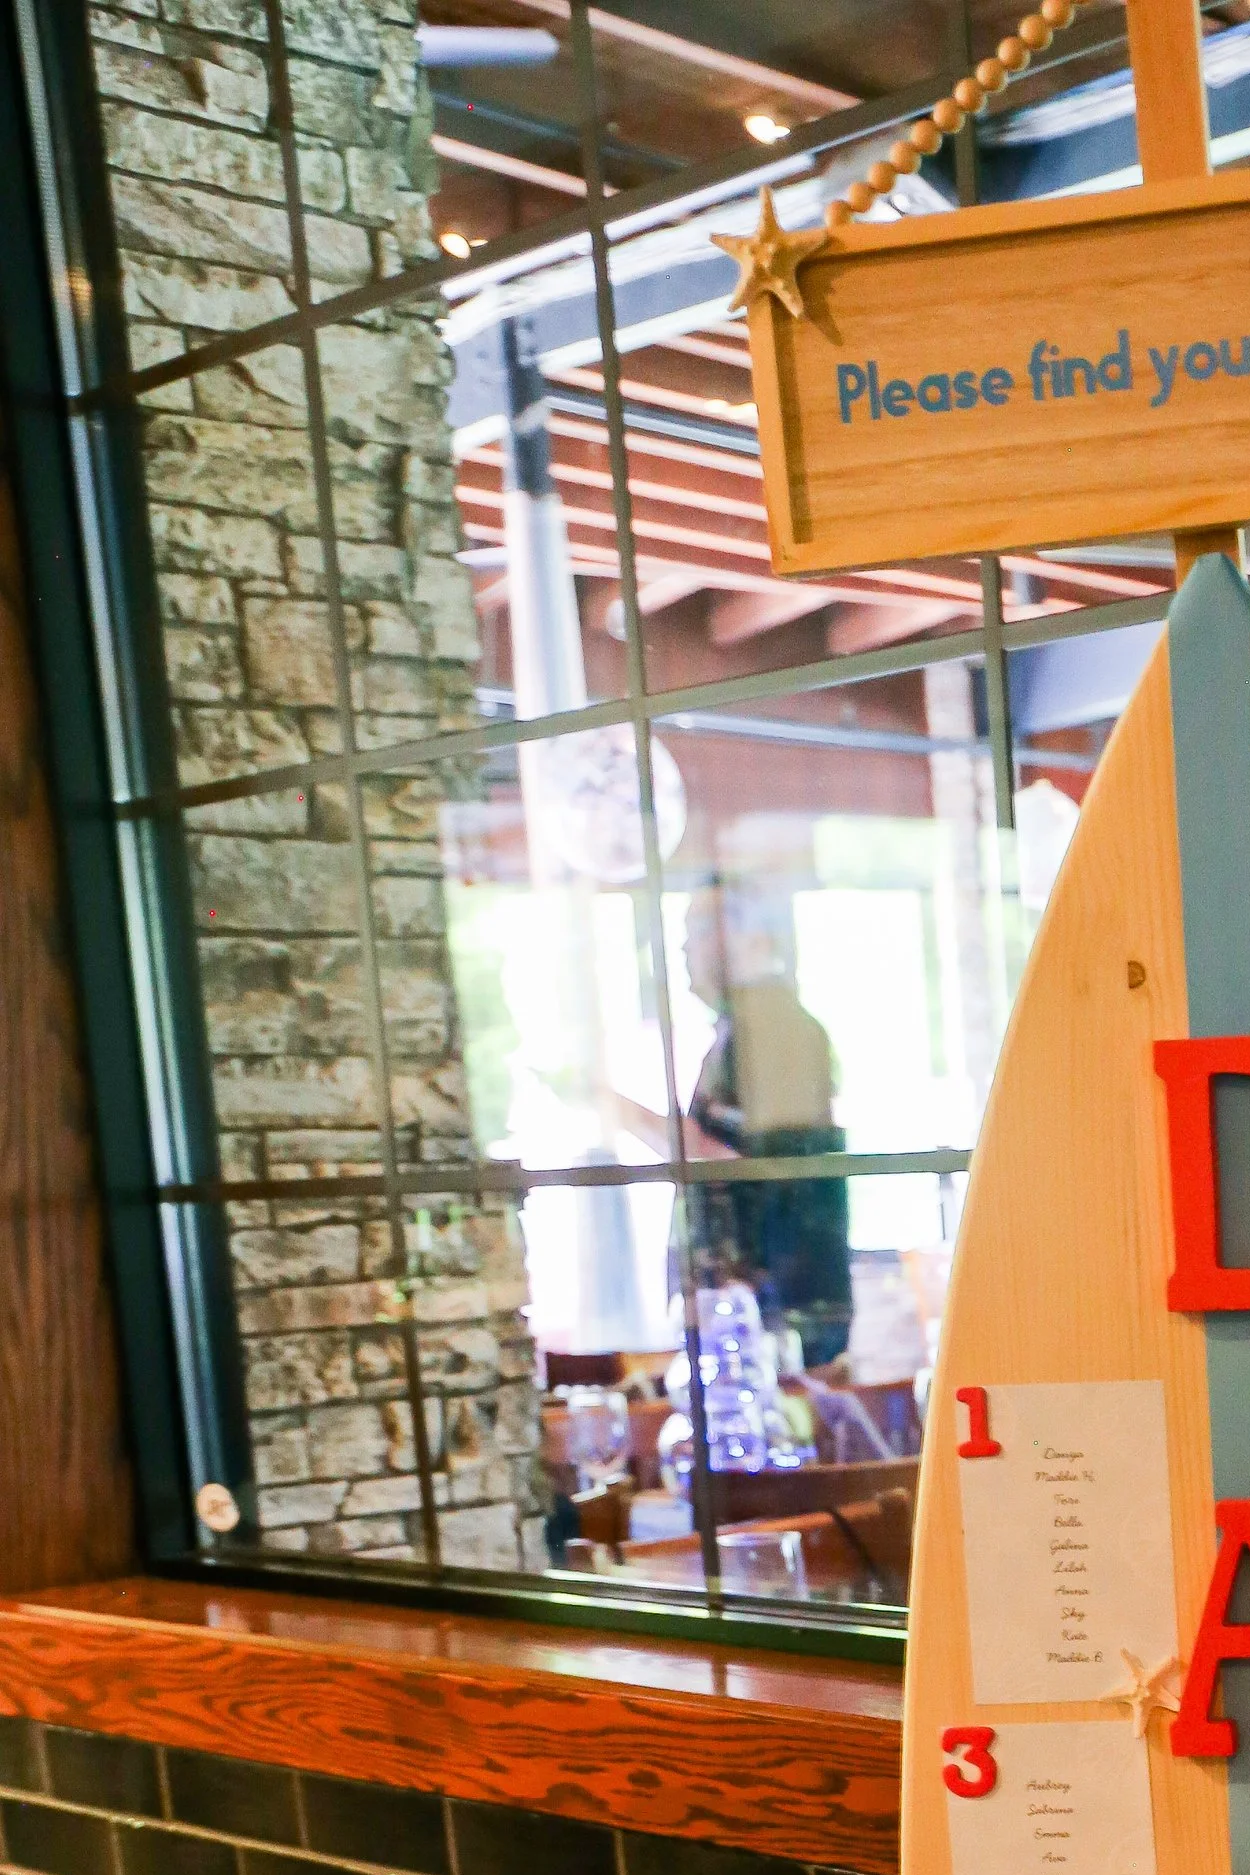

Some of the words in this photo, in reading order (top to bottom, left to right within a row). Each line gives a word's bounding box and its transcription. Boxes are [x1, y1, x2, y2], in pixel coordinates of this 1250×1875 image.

[836, 361, 1014, 424] Please
[1028, 328, 1132, 402] find
[956, 1386, 1001, 1460] 1
[941, 1725, 998, 1799] 3
